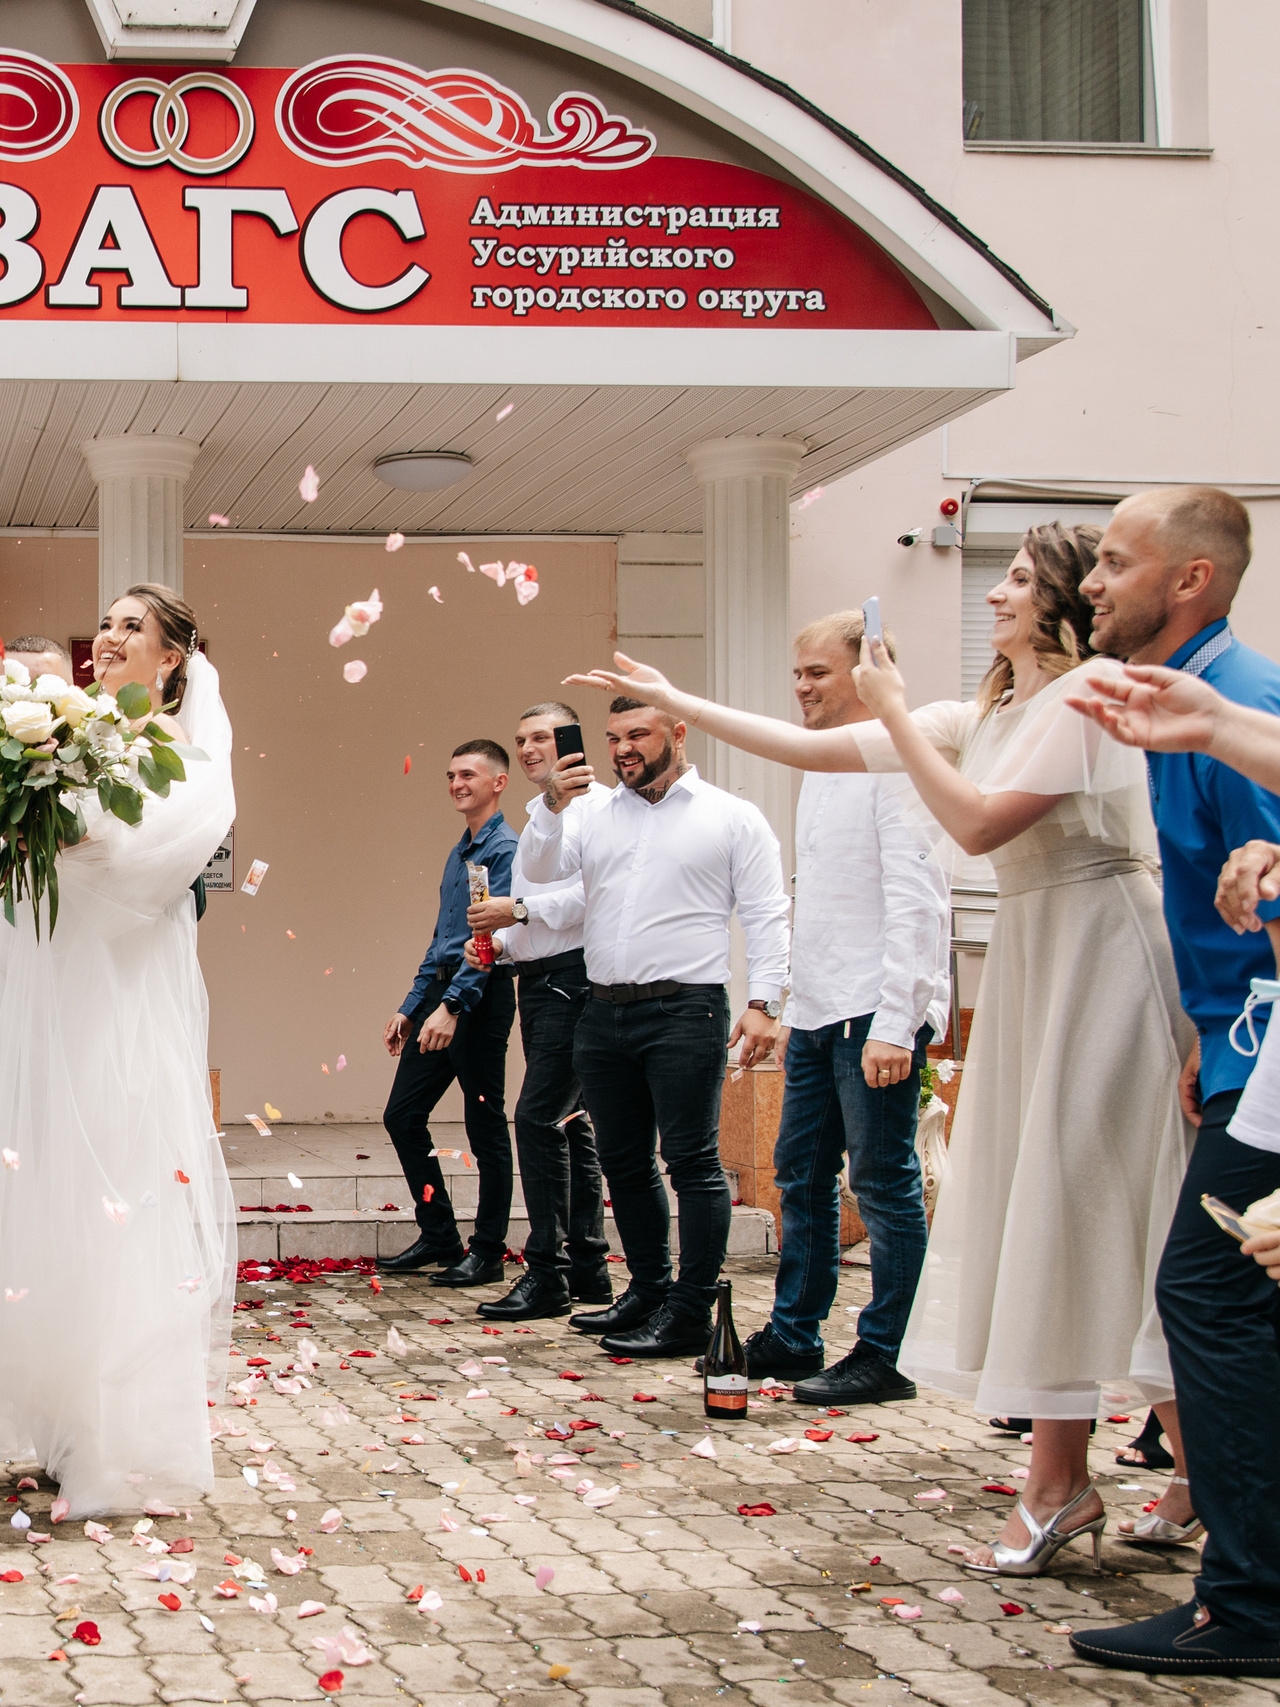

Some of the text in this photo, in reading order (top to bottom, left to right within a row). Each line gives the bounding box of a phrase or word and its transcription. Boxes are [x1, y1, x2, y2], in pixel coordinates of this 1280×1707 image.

[471, 197, 780, 233] Администрация
[471, 239, 735, 273] Уссурийского
[473, 286, 826, 317] городского округа
